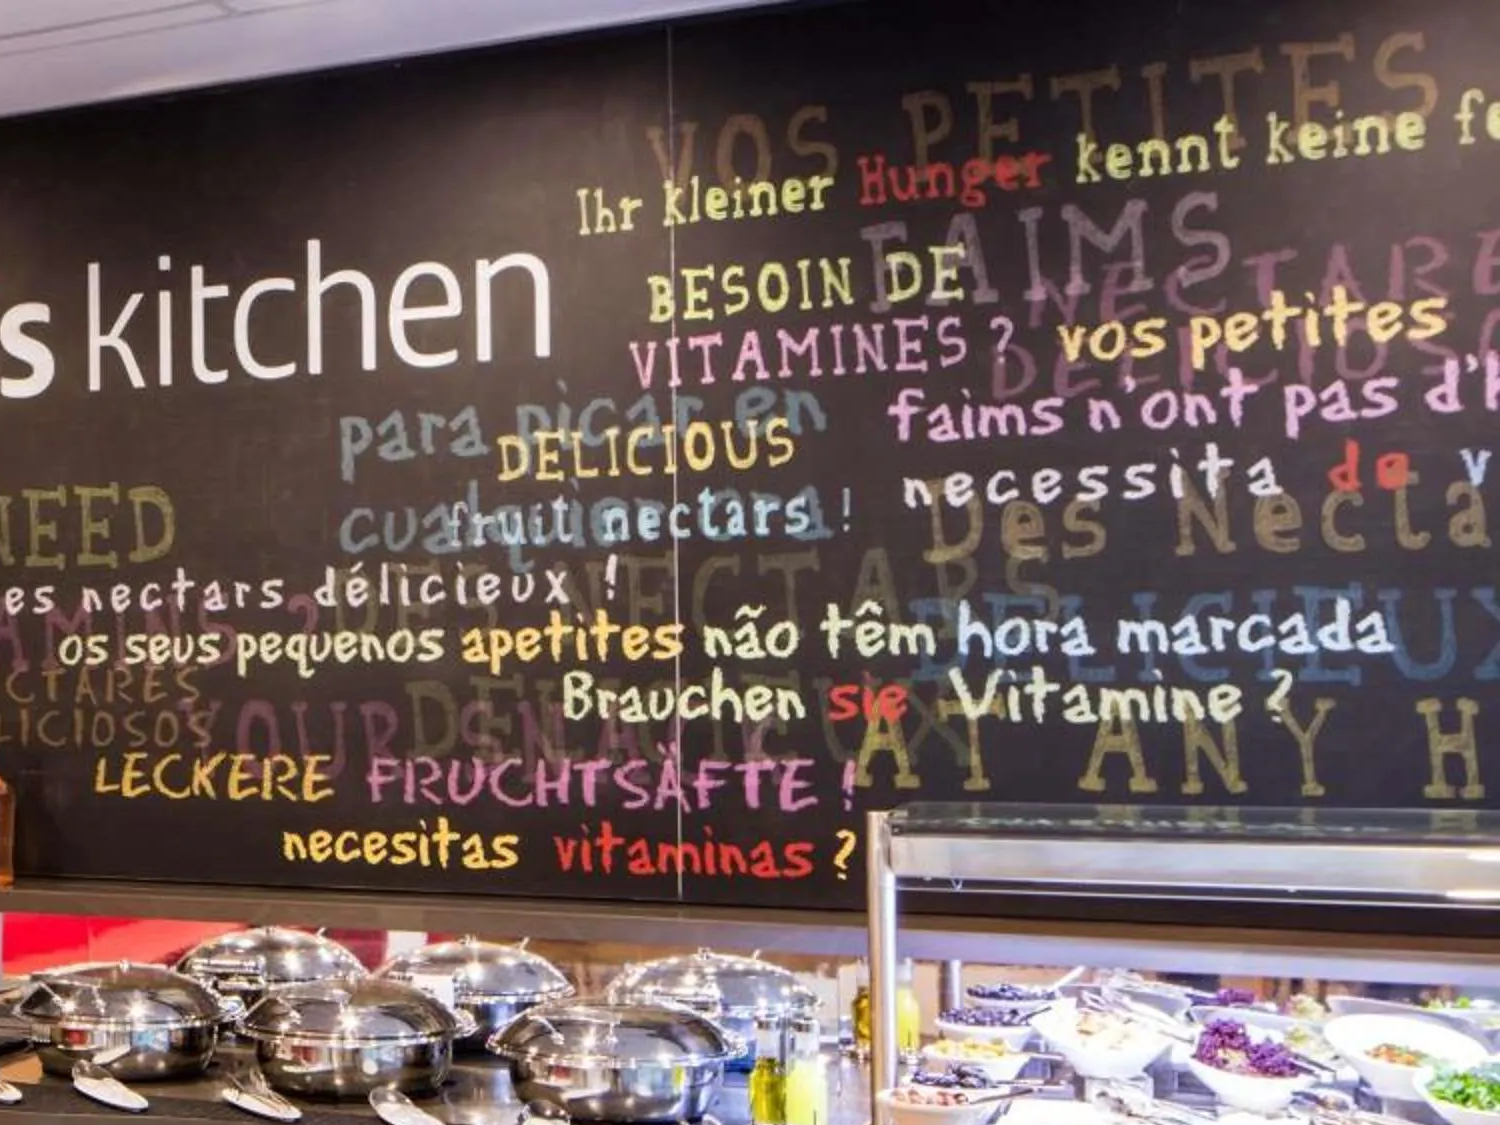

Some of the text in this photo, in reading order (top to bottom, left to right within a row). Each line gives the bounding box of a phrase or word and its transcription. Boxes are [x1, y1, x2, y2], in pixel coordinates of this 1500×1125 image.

[576, 187, 643, 236] Ihr
[663, 174, 835, 228] kleiner
[857, 150, 1052, 207] Hunger
[1075, 113, 1240, 184] kennt
[1266, 110, 1426, 165] keine
[87, 238, 551, 392] kitchen
[647, 243, 966, 324] BESOIN DE
[629, 315, 968, 389] VITAMINES
[1058, 284, 1448, 370] vos petites
[888, 388, 1064, 442] faims
[1088, 367, 1260, 432] n'ont
[1284, 375, 1400, 440] pas
[339, 404, 489, 483] para
[497, 416, 797, 483] DELICIOUS
[902, 441, 1285, 510] necessita
[1327, 438, 1411, 491] de
[604, 488, 812, 540] nectars
[82, 567, 285, 615] nectars
[314, 562, 570, 608] délicieux
[59, 596, 1396, 679] os seus pequenos apetites não têm hora marcada
[563, 667, 806, 722] Brauchen
[827, 670, 910, 722] sie
[949, 666, 1243, 726] Vitamine
[95, 751, 336, 804] LECKERE
[367, 742, 819, 814] FRUCHTSÄFTE
[283, 817, 521, 871] necesitas
[553, 821, 815, 879] vitaminas
